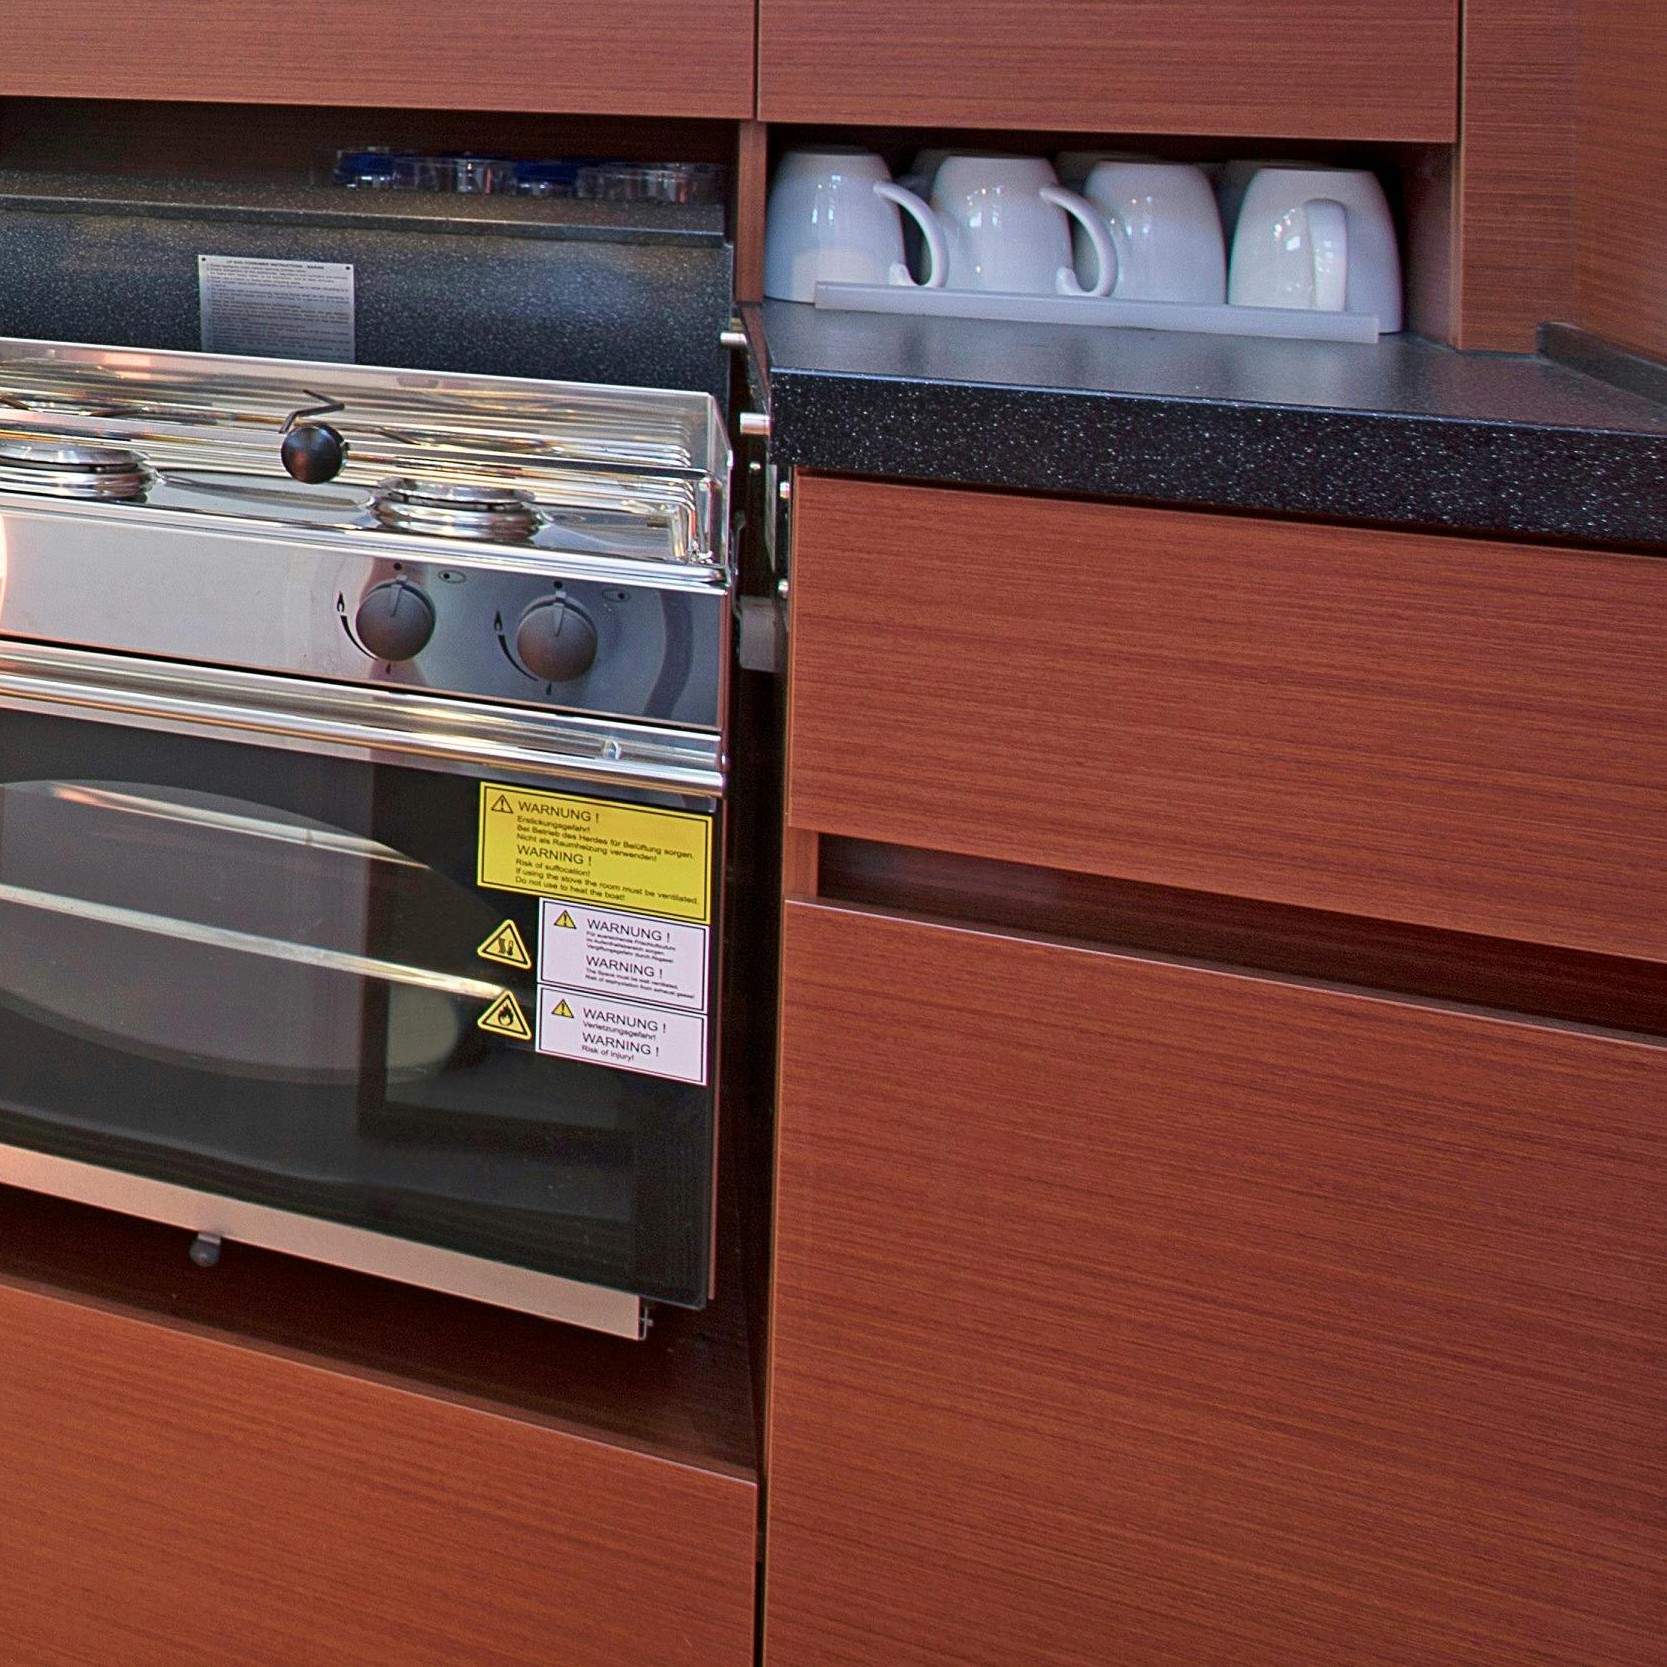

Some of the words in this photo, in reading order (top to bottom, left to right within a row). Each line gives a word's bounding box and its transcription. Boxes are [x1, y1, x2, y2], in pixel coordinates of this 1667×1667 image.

[518, 801, 591, 822] WARNUNG
[516, 833, 537, 842] Nicht
[539, 837, 551, 845] als
[552, 838, 608, 855] Raumheizung
[517, 824, 530, 832] Bei
[532, 826, 560, 837] Betrieb
[561, 832, 577, 840] des
[579, 834, 608, 845] Herdes
[610, 838, 621, 846] für
[623, 841, 662, 855] Belüftung
[517, 844, 584, 865] WARNING
[516, 858, 533, 867] Risk
[545, 864, 591, 876] suffocation!
[515, 876, 527, 884] Do
[528, 879, 542, 887] not
[570, 886, 587, 895] heat
[589, 889, 602, 898] the
[605, 892, 625, 901] boat!
[523, 869, 544, 879] using
[546, 873, 559, 881] the
[561, 875, 583, 884] stove
[585, 878, 597, 887] the
[599, 882, 621, 891] room
[622, 886, 643, 895] must
[645, 889, 655, 897] be
[587, 918, 662, 941] WARNUNG
[586, 955, 655, 977] WARNING
[583, 1007, 659, 1031] WARNUNG
[581, 1045, 599, 1054] Risk
[582, 1032, 652, 1055] WARNING
